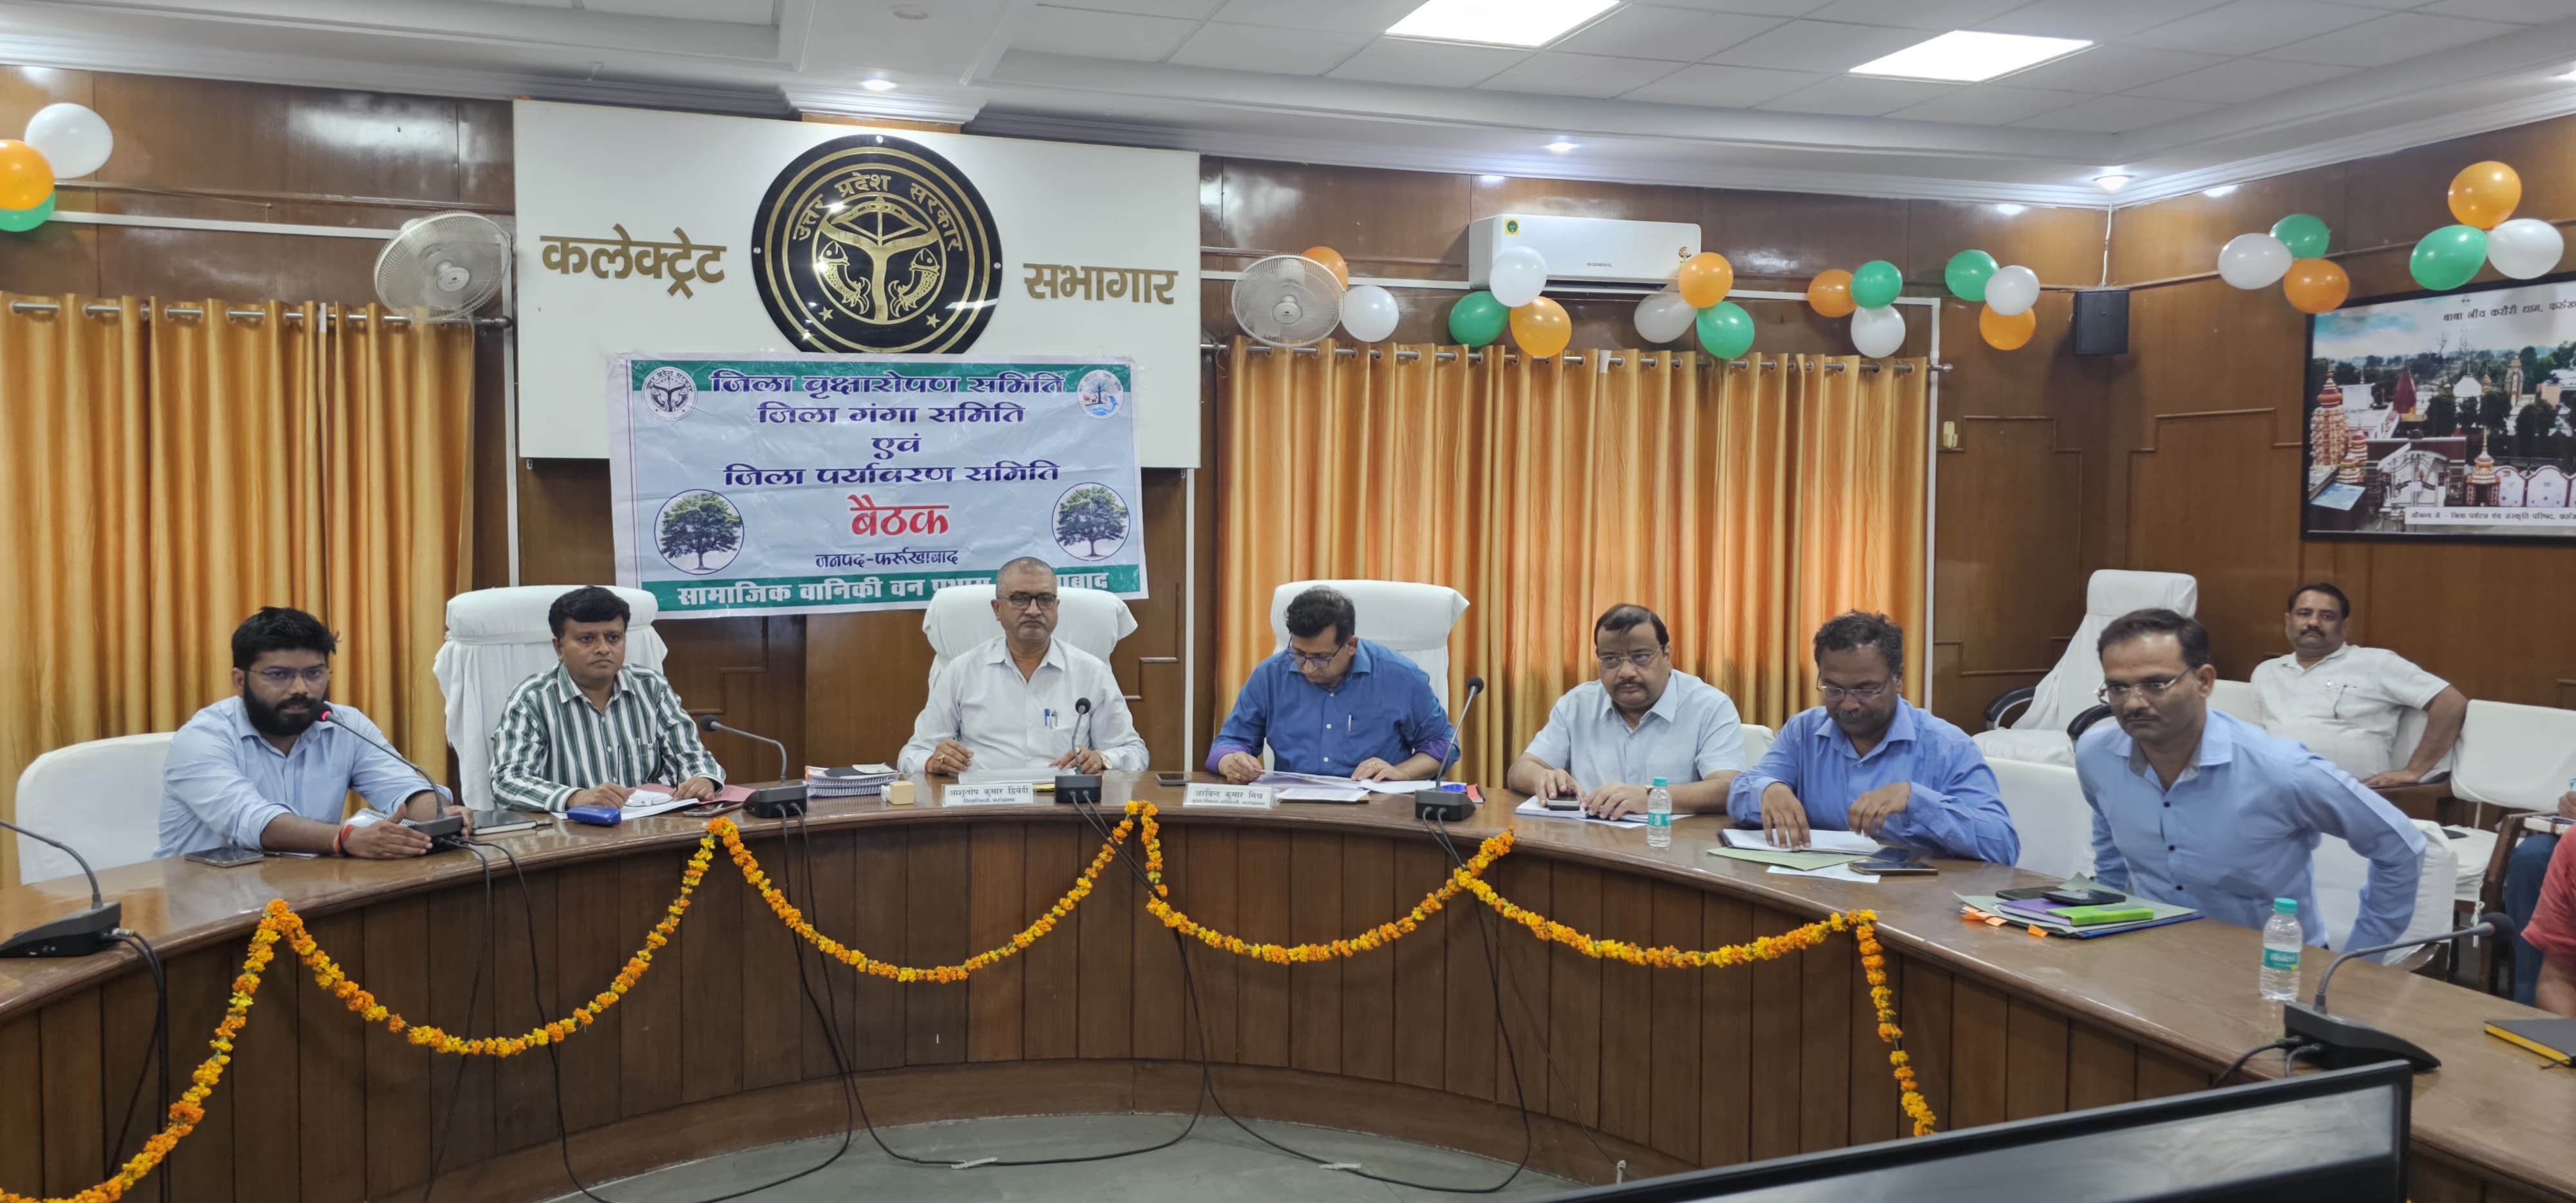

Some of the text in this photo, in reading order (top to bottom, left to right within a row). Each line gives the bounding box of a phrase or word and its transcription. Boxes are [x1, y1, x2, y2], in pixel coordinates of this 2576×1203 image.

[792, 171, 963, 251] उत्तर प्रदेश सरकार
[540, 223, 727, 299] कलेक्ट्रेट
[1023, 263, 1179, 305] सभागार
[710, 368, 795, 392] जिला
[802, 370, 961, 399] वृक्षारोपण
[967, 371, 1065, 393] समिति
[757, 401, 1025, 423] जिला गंगा समिति
[871, 433, 922, 460] एवं
[723, 459, 1060, 486] जिला पर्यावरण समिति
[847, 494, 949, 536] बैठक
[677, 581, 791, 605] सामाजिक
[799, 576, 883, 600] वानिकी
[889, 580, 925, 596] वन
[984, 788, 1003, 797] कुमार
[1225, 791, 1244, 799] कुमार
